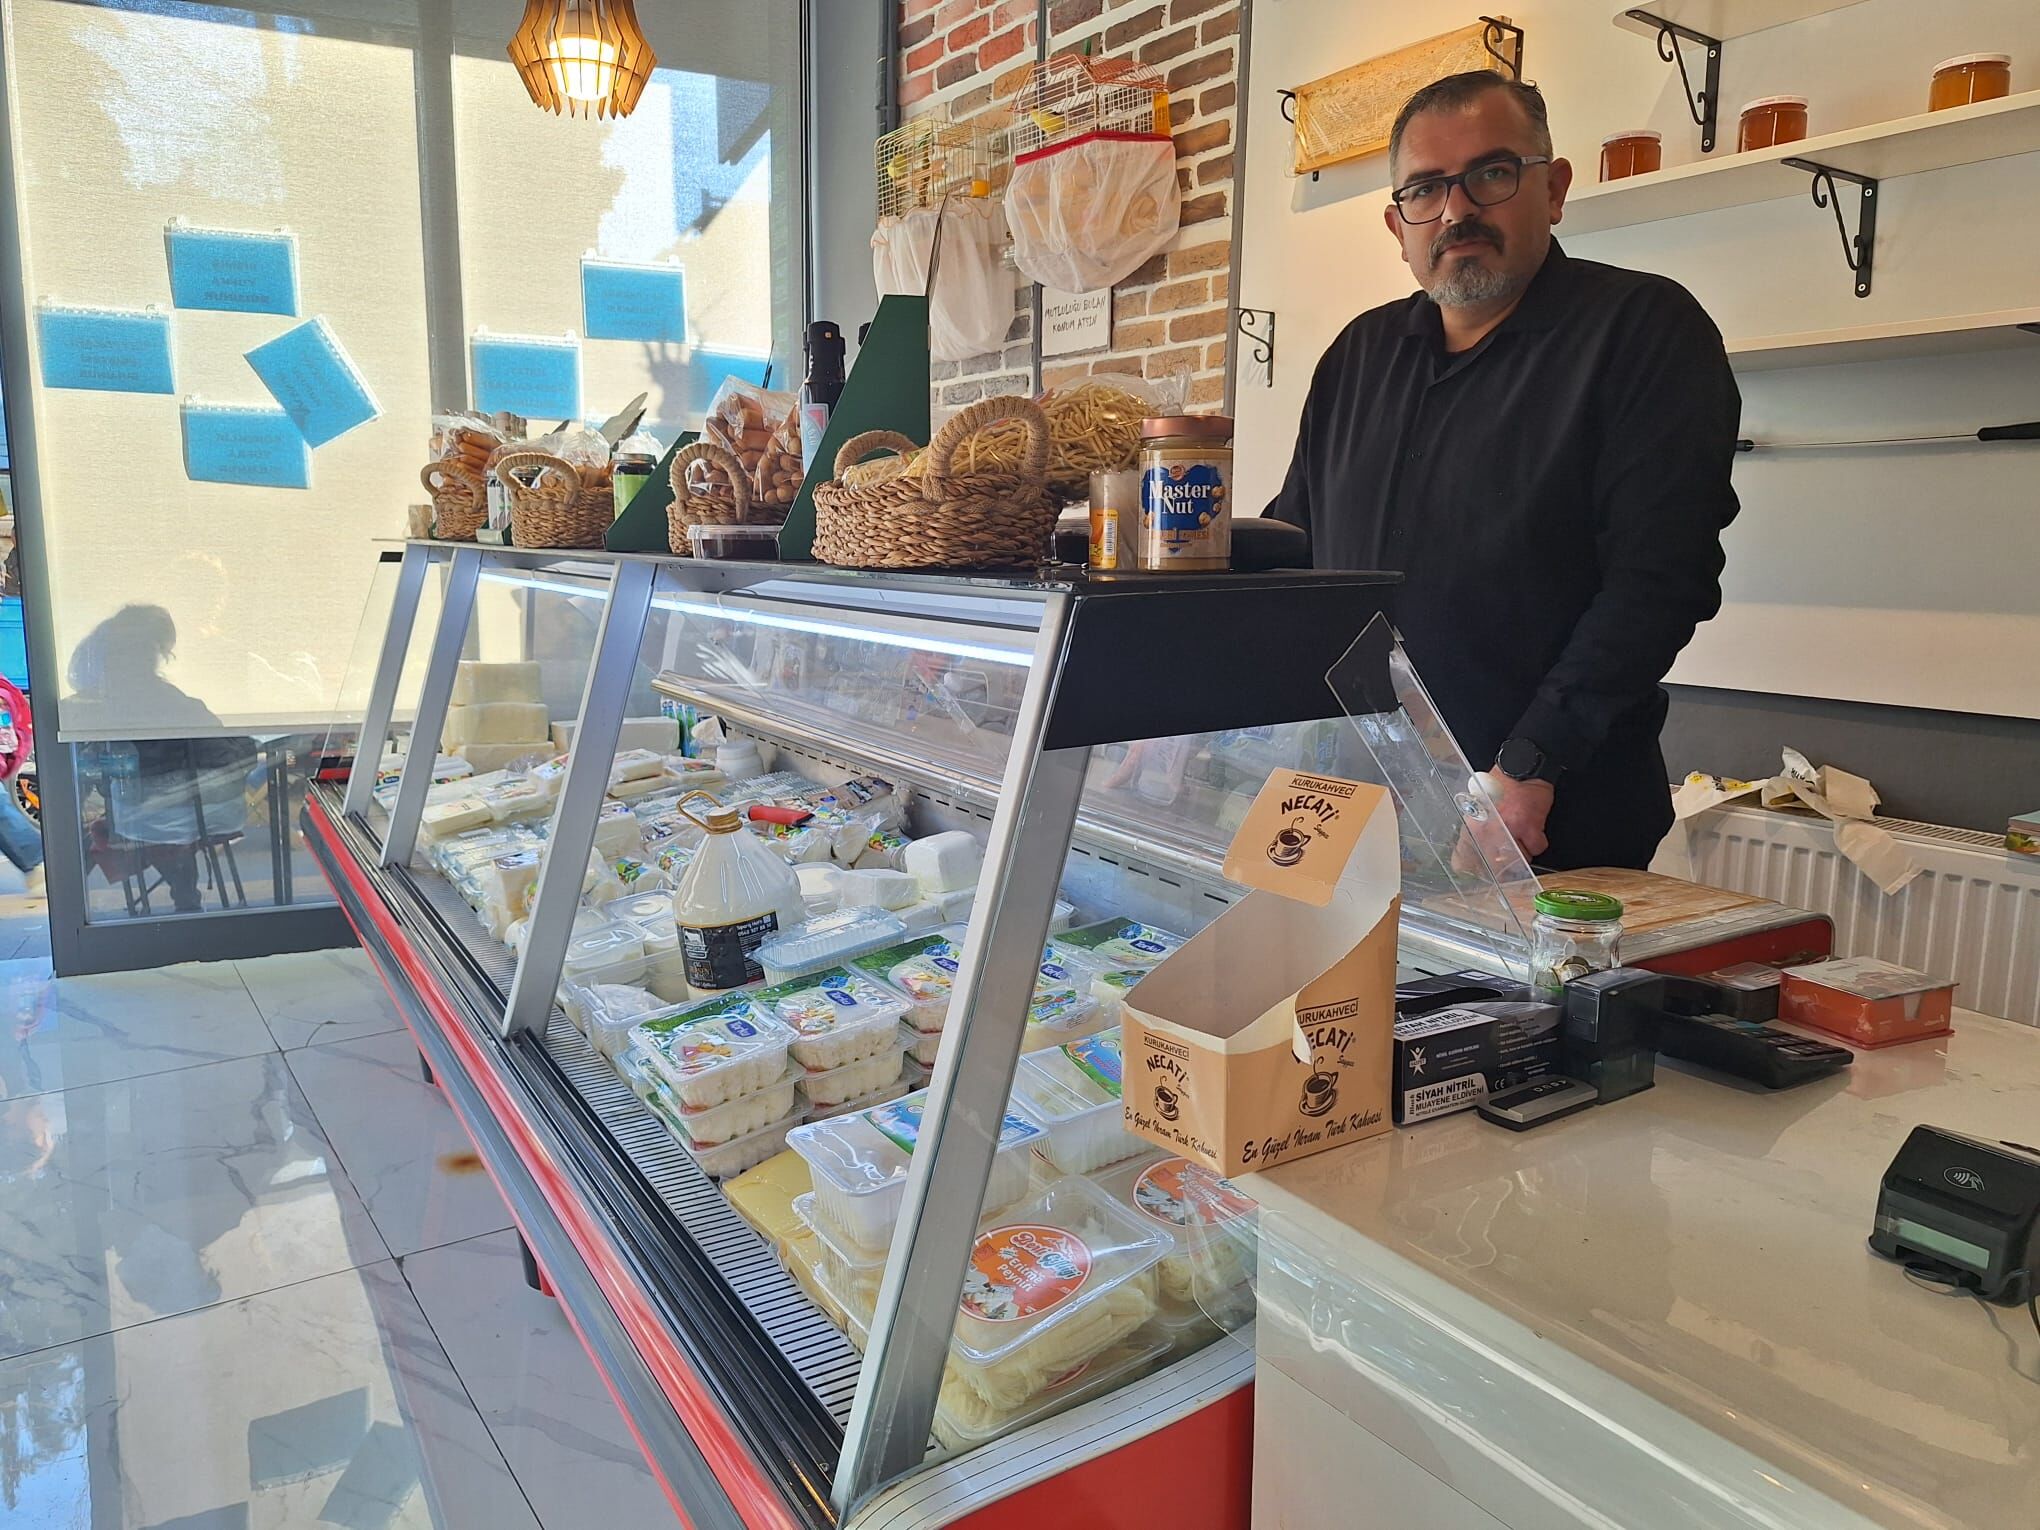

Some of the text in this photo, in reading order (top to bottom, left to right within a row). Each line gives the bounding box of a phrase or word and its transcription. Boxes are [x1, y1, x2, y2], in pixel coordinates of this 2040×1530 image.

[1083, 296, 1106, 311] BULAN
[1052, 319, 1075, 333] KONUM
[1149, 480, 1211, 499] Master
[1162, 497, 1194, 514] Nut
[1281, 795, 1339, 822] NECATİ
[1298, 1000, 1359, 1025] URUKAHVECİ
[1305, 1026, 1354, 1054] ECATİ
[1146, 1054, 1187, 1083] NECATİ
[1416, 1078, 1476, 1102] SİYAH NİTRİL
[1416, 1086, 1484, 1111] MUAYENE ELDİVENİ
[1125, 1106, 1133, 1120] En
[1135, 1112, 1151, 1130] Güzel
[1173, 1129, 1189, 1146] Türk
[1191, 1137, 1217, 1159] Kahvesi
[1242, 1140, 1259, 1163] En
[1261, 1133, 1289, 1164] Güzel
[1325, 1118, 1347, 1139] Türk
[1349, 1108, 1383, 1131] Kahvesi
[997, 1263, 1036, 1292] Peyniri
[1009, 1258, 1045, 1284] Eritme
